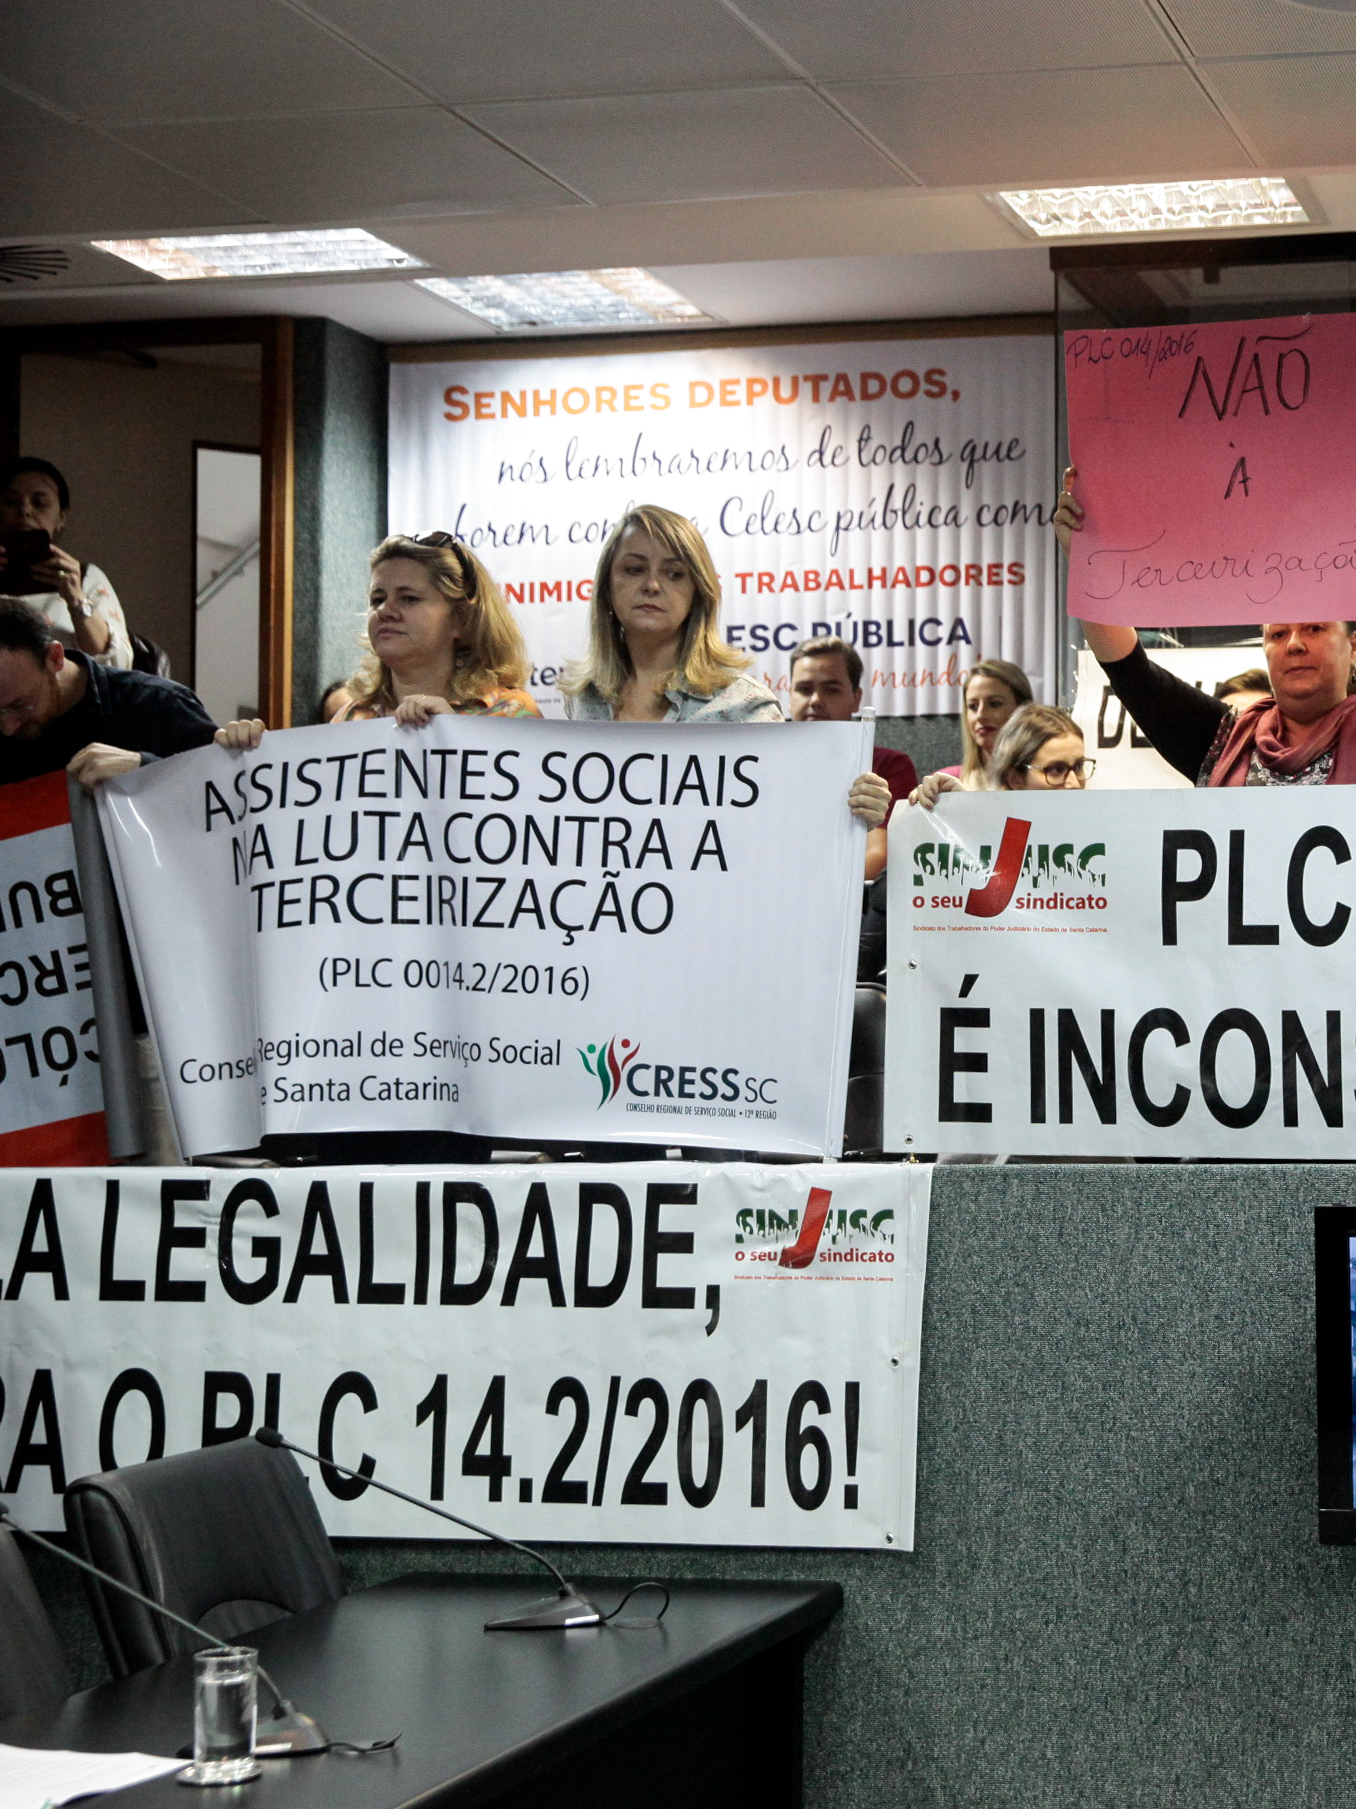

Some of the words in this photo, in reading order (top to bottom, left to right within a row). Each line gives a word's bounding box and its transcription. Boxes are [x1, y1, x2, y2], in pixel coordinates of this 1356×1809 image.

[1067, 335, 1113, 367] PLC
[1178, 323, 1314, 421] NÃO
[444, 381, 672, 423] SENHORES
[688, 367, 960, 409] DEPUTADOS,
[498, 448, 554, 485] nós
[564, 432, 799, 483] lembraremos
[808, 425, 849, 469] de
[857, 420, 952, 467] todos
[960, 432, 1027, 489] que
[720, 488, 829, 538] Celesc
[833, 483, 969, 557] pública
[503, 580, 594, 604] NIMIG
[735, 563, 1026, 595] TRABALHADORES
[726, 623, 799, 652] ESC
[204, 747, 521, 833] ASSISTENTES
[538, 751, 761, 809] SOCIAIS
[232, 823, 275, 886] NA
[294, 810, 435, 866] LUTA
[443, 812, 674, 870] CONTRA
[690, 819, 728, 872] A
[0, 869, 84, 933] BU
[251, 870, 675, 946] TERCEIRIZAÇÃO
[912, 895, 925, 908] o
[931, 895, 963, 908] seu
[1015, 892, 1108, 910] sindicato
[1162, 825, 1352, 947] PLC
[318, 955, 393, 991] (PLC
[403, 959, 590, 1001] 0014.2/2016)
[179, 1057, 256, 1085] Conse
[370, 1031, 404, 1058] de
[413, 1032, 482, 1068] Serviço
[488, 1037, 561, 1066] Social
[938, 973, 993, 1124] É
[273, 1076, 351, 1104] Santa
[359, 1075, 460, 1103] Catarina
[626, 1063, 740, 1102] CRESS
[744, 1077, 778, 1104] SC
[626, 1103, 655, 1113] CONSELHO
[656, 1105, 683, 1115] REGIONAL
[685, 1106, 693, 1115] DE
[694, 1106, 716, 1118] SERVIÇO
[718, 1108, 736, 1118] SOCIAL
[755, 1109, 777, 1120] REGIÃO
[0, 1178, 70, 1301] A
[99, 1178, 722, 1337] LEGALIDADE,
[735, 1251, 745, 1261] o
[750, 1251, 778, 1261] seu
[819, 1248, 895, 1263] sindicato
[0, 1369, 67, 1494] A
[99, 1367, 166, 1473] O
[415, 1374, 862, 1511] 14.2/2016!
